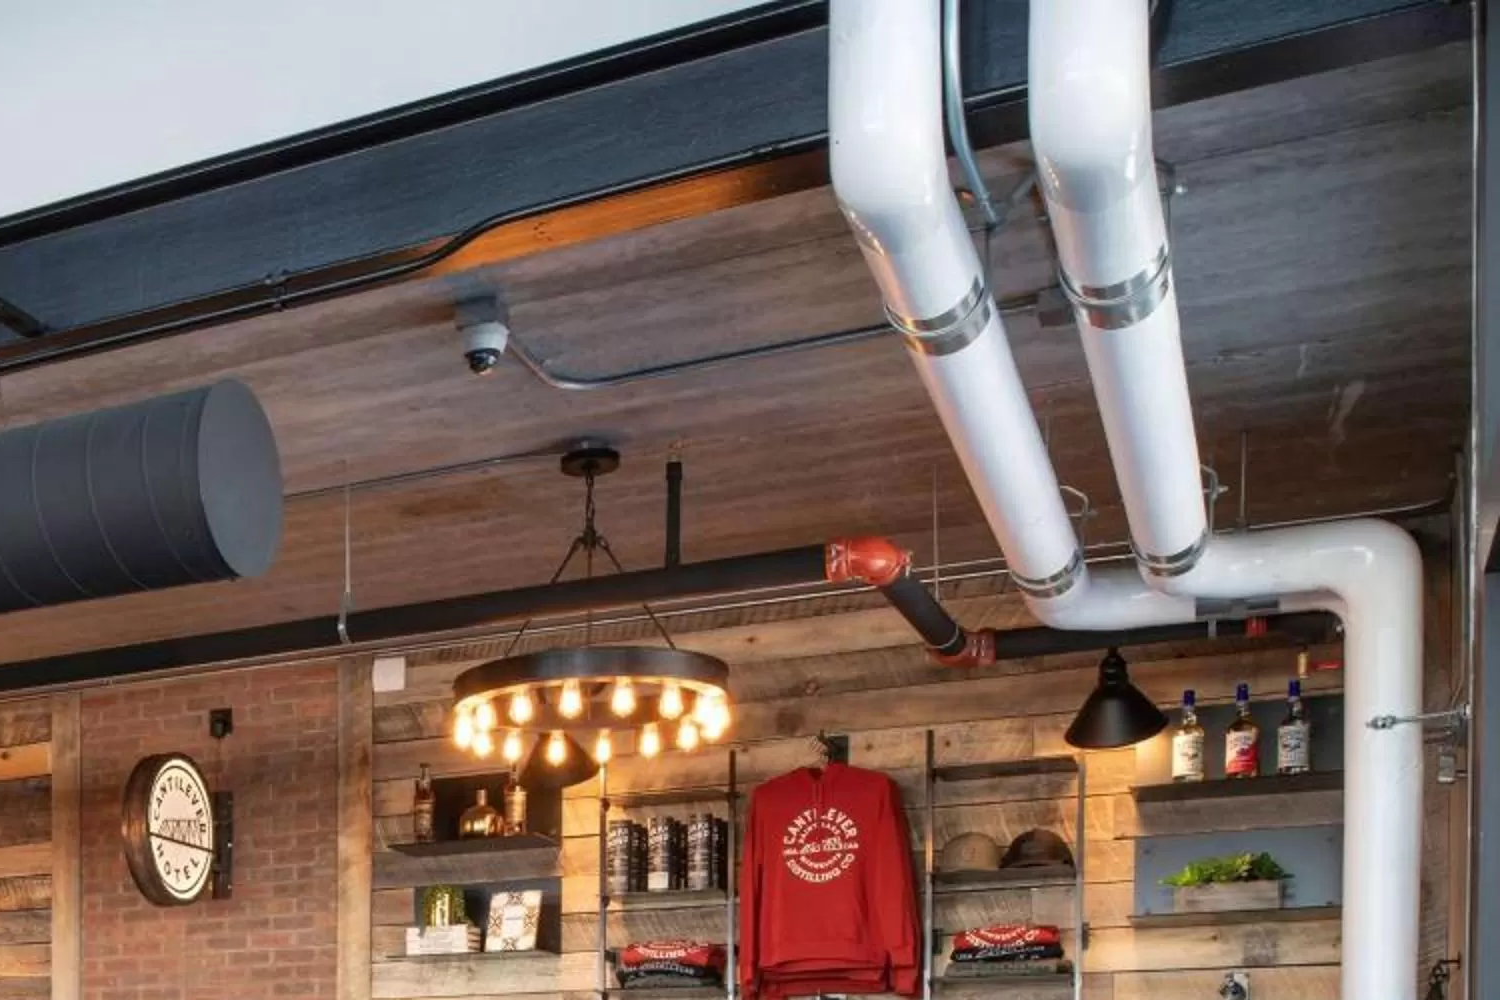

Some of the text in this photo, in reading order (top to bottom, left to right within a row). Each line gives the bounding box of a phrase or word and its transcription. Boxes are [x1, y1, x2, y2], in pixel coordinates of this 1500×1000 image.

[154, 776, 206, 833] CANTILEVER
[157, 843, 200, 882] HOTEL
[786, 853, 855, 883] DISTILLING CO
